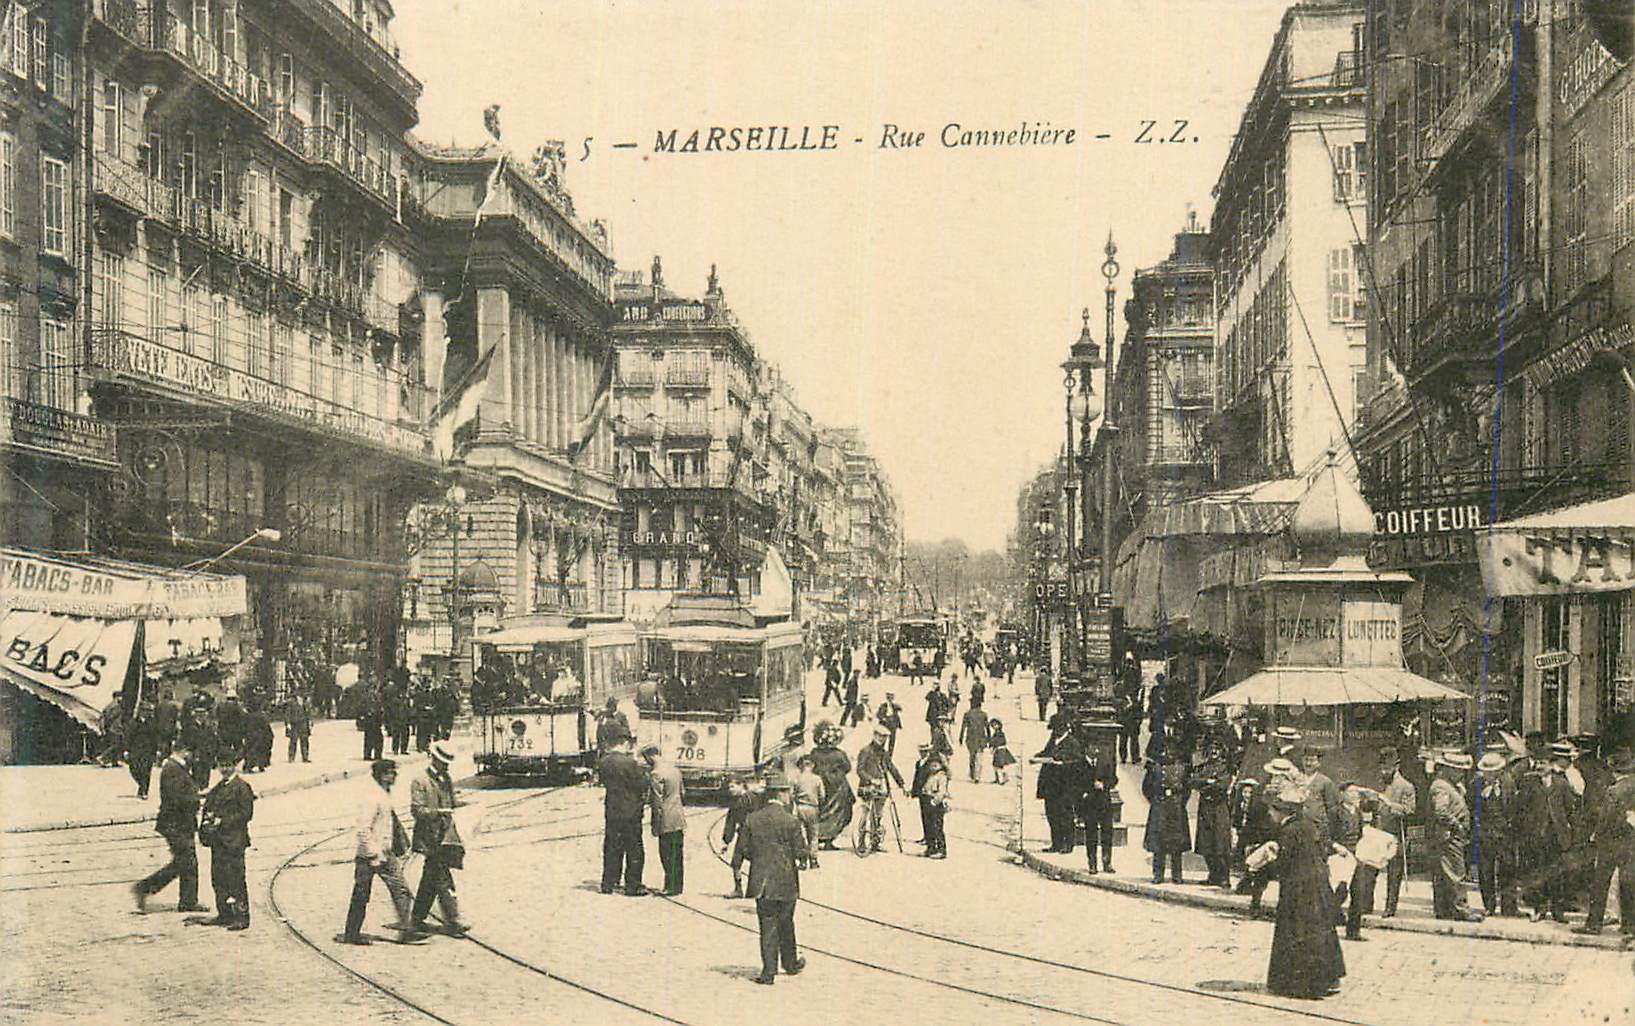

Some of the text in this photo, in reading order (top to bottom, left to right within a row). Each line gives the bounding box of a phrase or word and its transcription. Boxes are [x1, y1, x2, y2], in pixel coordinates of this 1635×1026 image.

[1373, 505, 1481, 535] COIFFEUR
[632, 531, 695, 545] GRAND
[1346, 618, 1398, 641] LUNETTES
[509, 738, 534, 750] 732
[676, 747, 706, 761] 708
